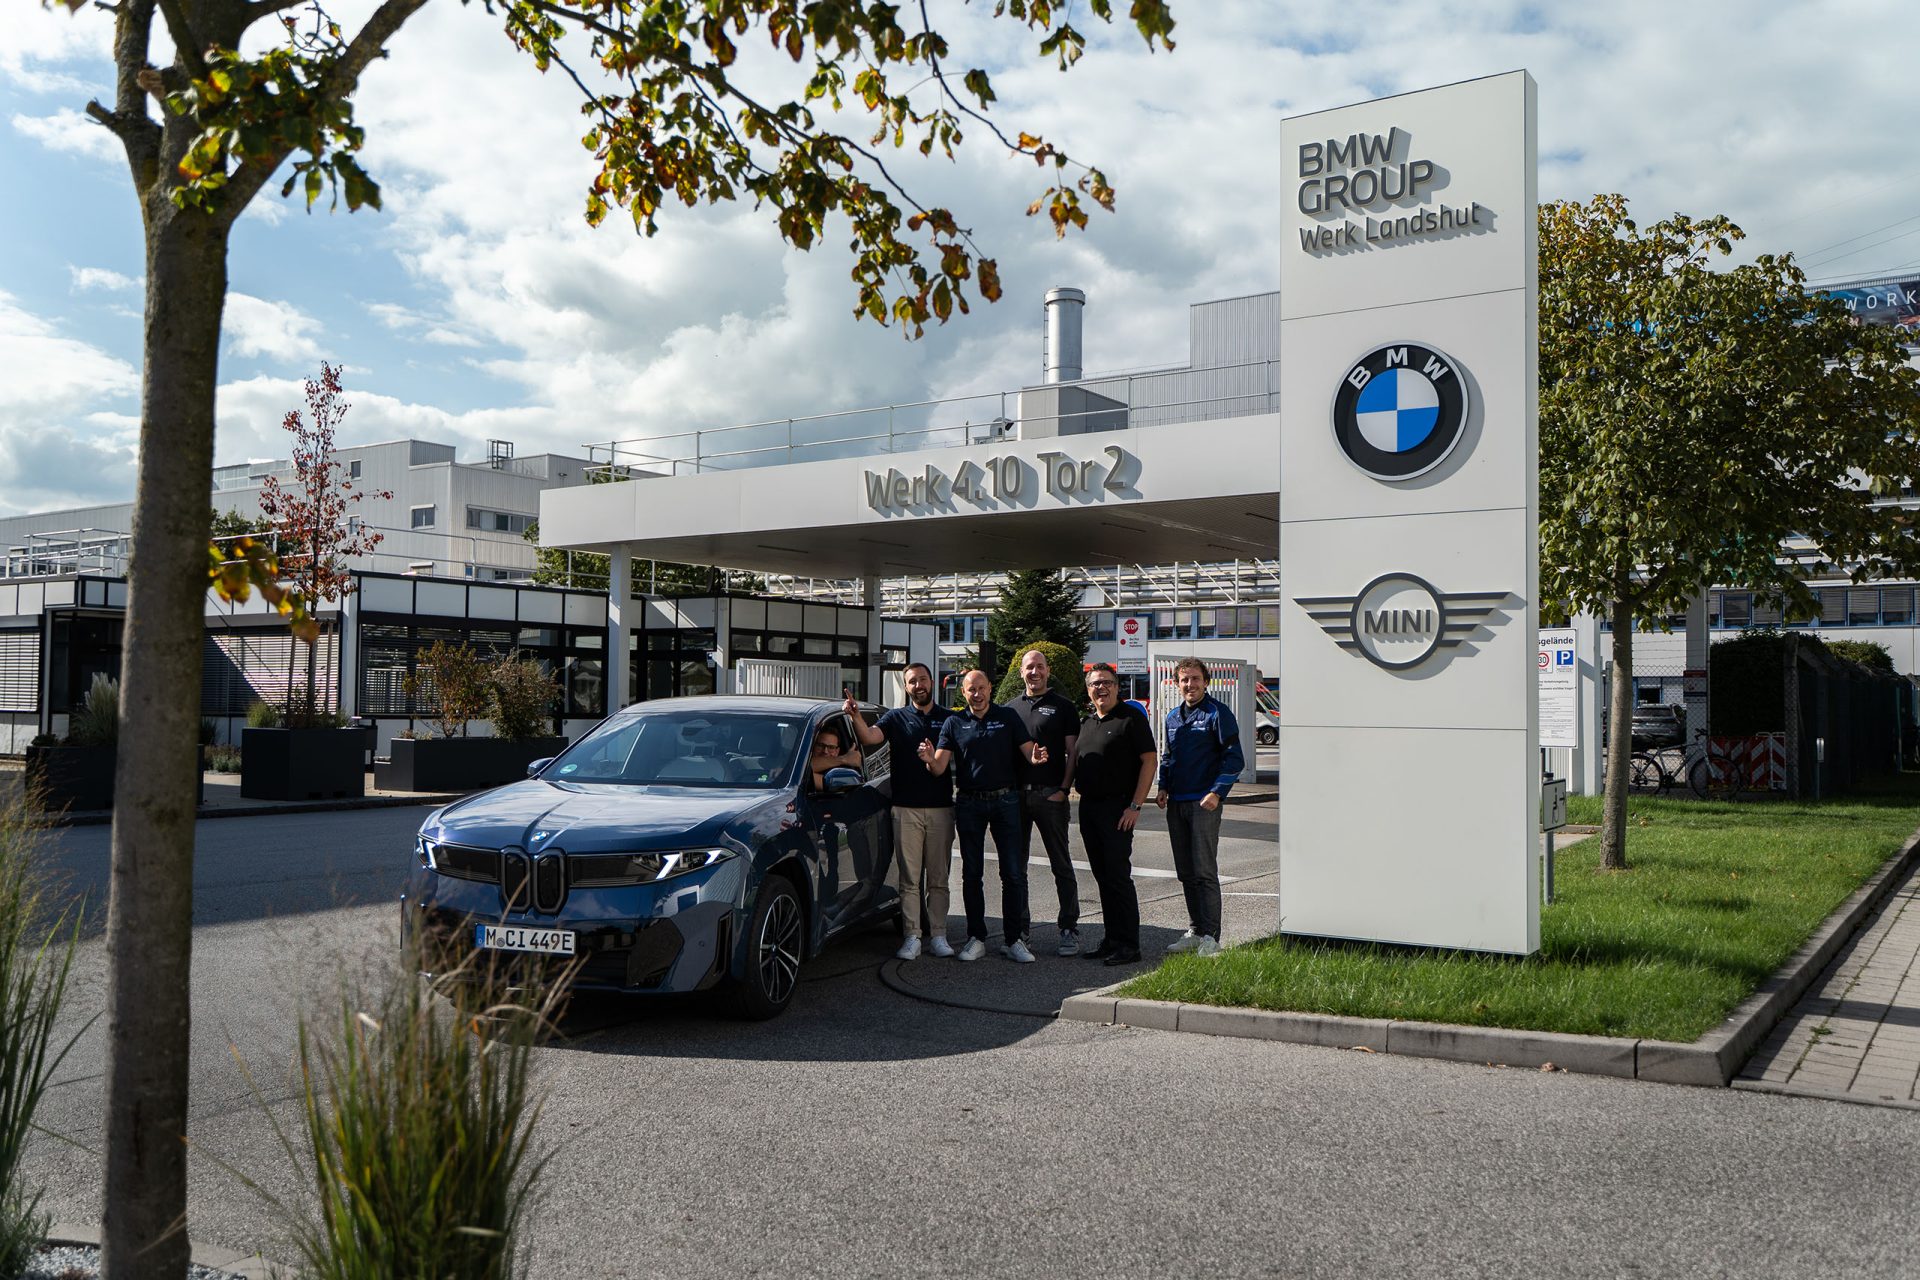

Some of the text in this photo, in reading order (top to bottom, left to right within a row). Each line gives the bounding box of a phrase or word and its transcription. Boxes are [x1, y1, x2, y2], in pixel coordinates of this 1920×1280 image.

[1299, 127, 1396, 177] BMW
[1298, 160, 1434, 214] GROUP
[1299, 202, 1480, 252] Werk Landshut
[1348, 347, 1449, 390] BMW
[865, 445, 1127, 508] Werk 4.10 Tor 2
[1364, 609, 1431, 634] MINI
[1561, 651, 1571, 665] P
[486, 928, 497, 946] M
[529, 932, 573, 951] 449E
